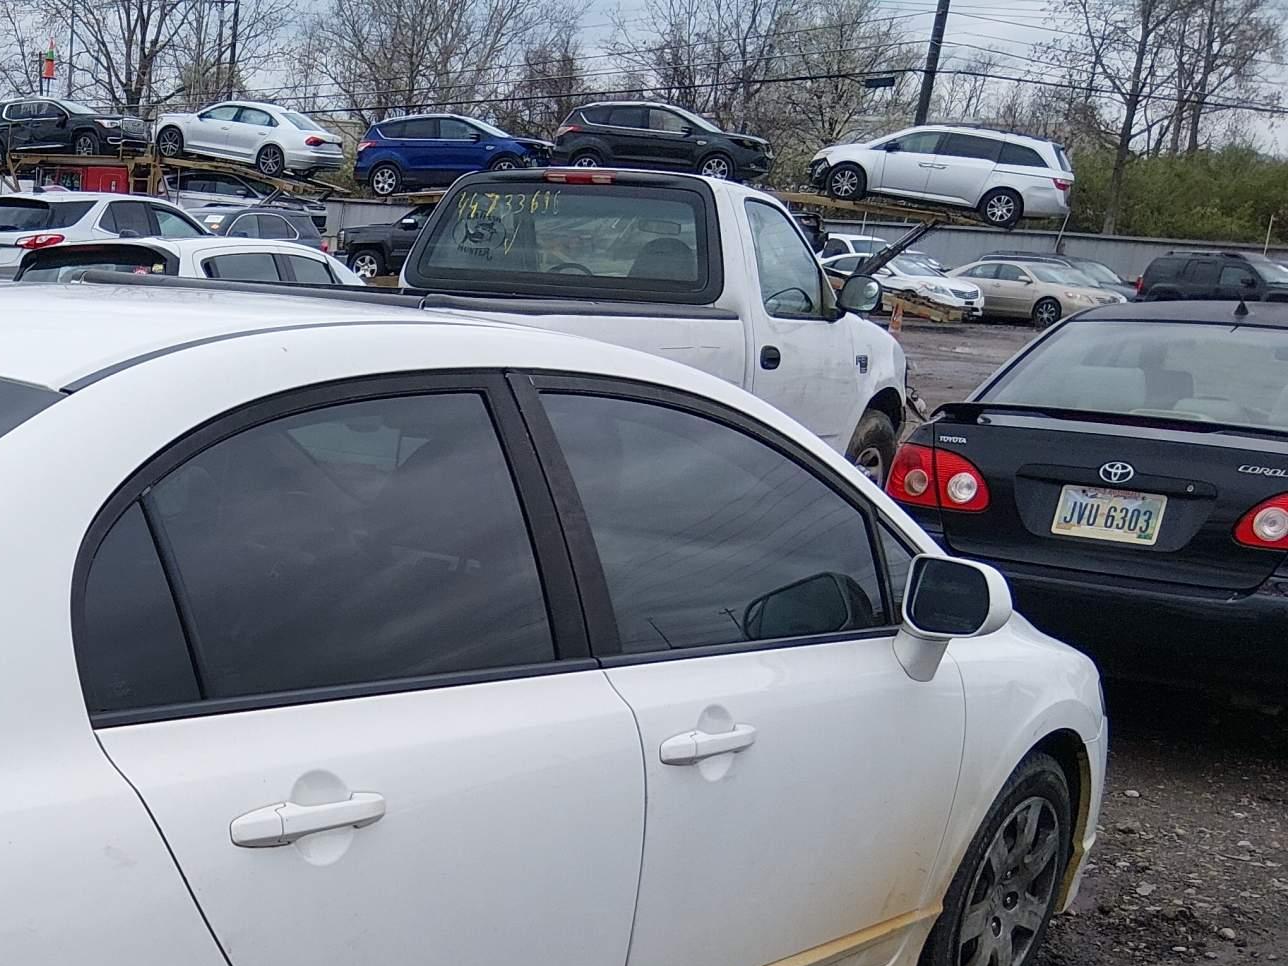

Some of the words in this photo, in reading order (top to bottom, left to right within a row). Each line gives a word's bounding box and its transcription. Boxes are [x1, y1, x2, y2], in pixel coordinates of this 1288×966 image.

[939, 435, 967, 444] TOYOTA
[1063, 501, 1100, 526] JVU
[1103, 505, 1153, 534] 6303
